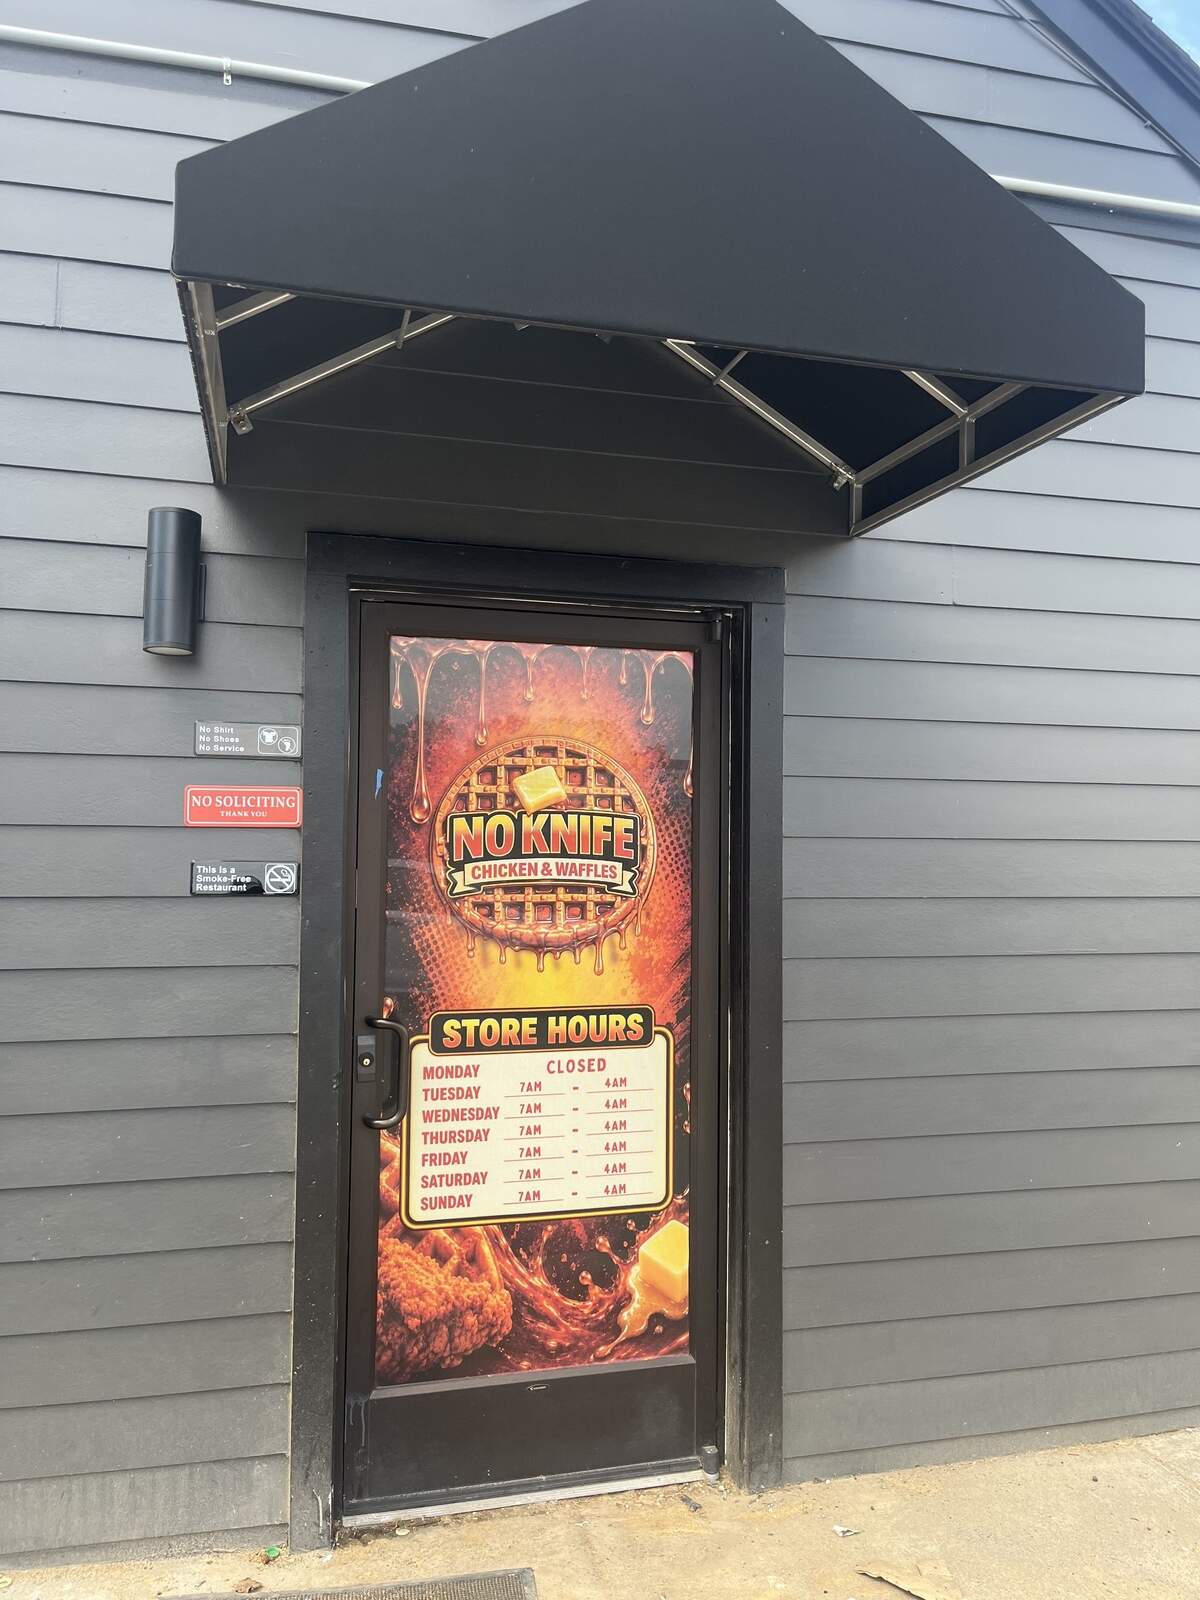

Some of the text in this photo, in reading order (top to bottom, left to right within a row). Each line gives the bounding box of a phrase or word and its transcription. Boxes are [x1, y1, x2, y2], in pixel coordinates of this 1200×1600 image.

[199, 734, 240, 743] No Shoes
[200, 725, 234, 734] No Shirt
[199, 744, 245, 752] No Service
[192, 795, 296, 808] NO SOLICITING
[453, 813, 635, 862] NO KNIFE
[196, 866, 217, 874] This
[219, 866, 228, 874] is
[196, 874, 252, 883] Smoke-Free
[471, 861, 618, 880] CHICKEN & WAFFLES
[196, 883, 248, 892] Restaurant
[442, 1013, 644, 1048] STORE HOURS
[423, 1058, 607, 1080] MONDAY CLOSED
[422, 1086, 481, 1102] TUESDAY
[520, 1081, 542, 1093] 7AM
[604, 1077, 627, 1088] 4AM
[422, 1106, 500, 1124] WEDNESDAY
[520, 1102, 542, 1114] 7AM
[604, 1098, 627, 1109] 4AM
[421, 1128, 490, 1145] THURSDAY
[519, 1124, 541, 1136] 7AM
[604, 1120, 627, 1131] 4AM
[421, 1151, 468, 1167] FRIDAY
[519, 1146, 541, 1158] 7AM
[604, 1141, 626, 1152] 4AM
[420, 1171, 488, 1189] SATURDAY
[518, 1168, 541, 1180] 7AM
[604, 1162, 626, 1174] 4AM
[420, 1194, 473, 1211] SUNDAY
[518, 1190, 540, 1202] 7AM
[604, 1183, 626, 1195] 4AM
